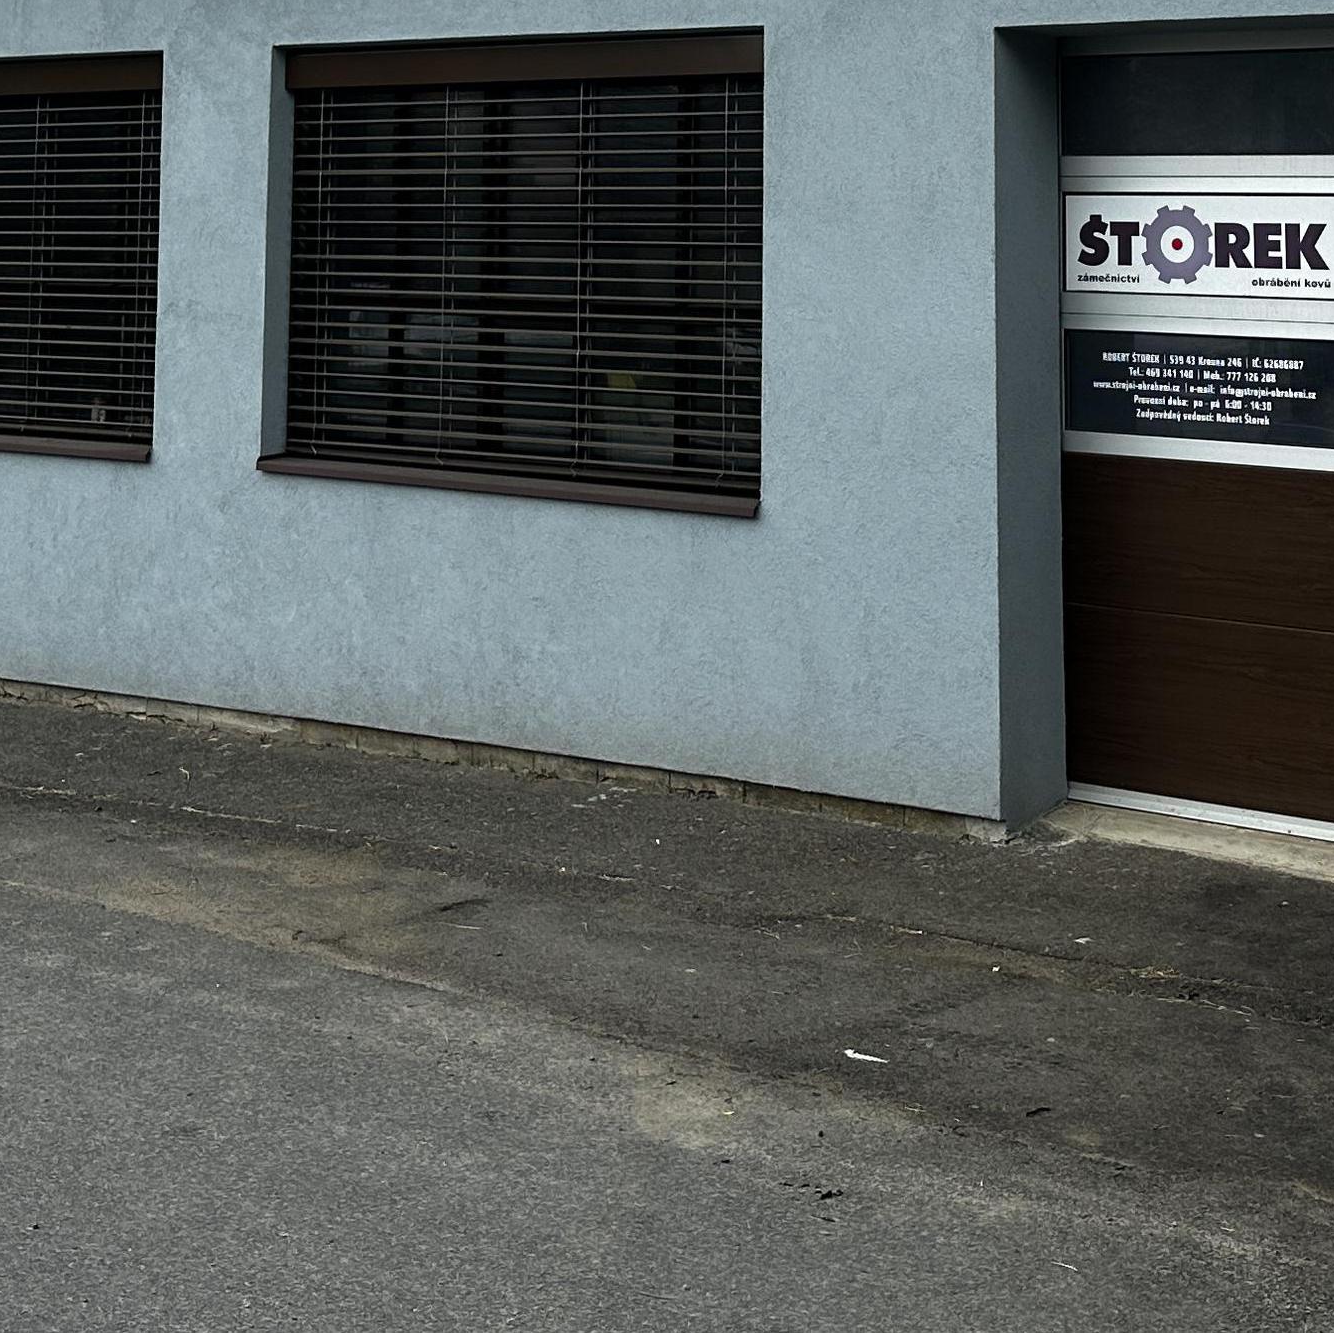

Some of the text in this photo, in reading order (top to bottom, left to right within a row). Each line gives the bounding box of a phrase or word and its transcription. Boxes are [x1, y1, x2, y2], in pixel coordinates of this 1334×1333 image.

[1169, 354, 1184, 365] 539
[1186, 355, 1195, 366] 43
[1227, 357, 1242, 368] 246
[1227, 371, 1241, 382] 777
[1250, 400, 1272, 411] 14:30
[1216, 412, 1242, 424] Robert
